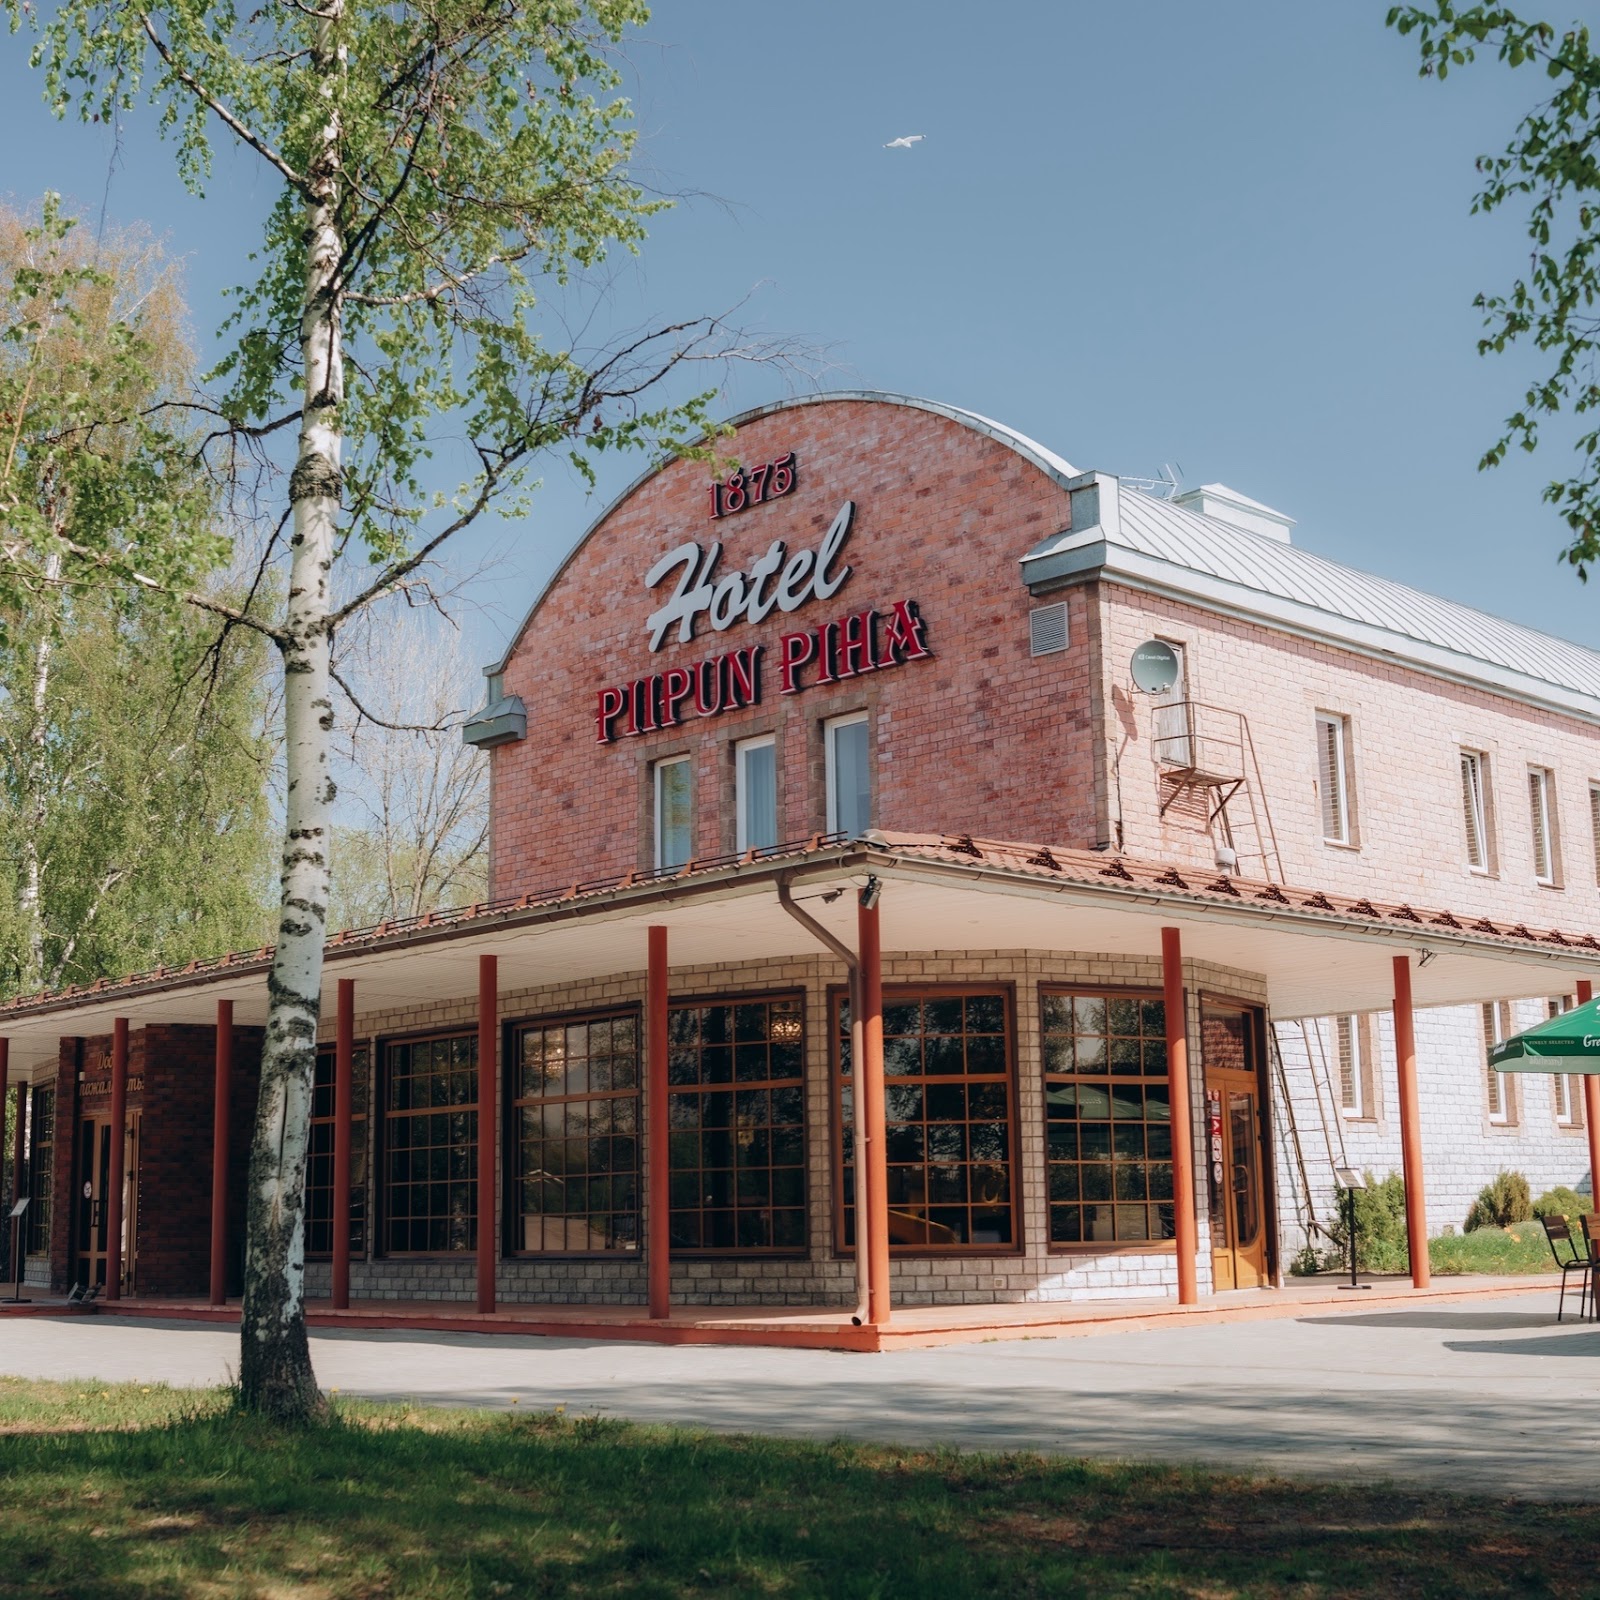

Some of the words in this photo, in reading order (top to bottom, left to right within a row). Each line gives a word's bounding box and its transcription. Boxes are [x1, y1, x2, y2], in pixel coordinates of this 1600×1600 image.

[706, 451, 796, 520] 1875
[645, 501, 856, 652] Hotel
[594, 646, 765, 744] PIIPUN
[778, 600, 935, 695] PIHA
